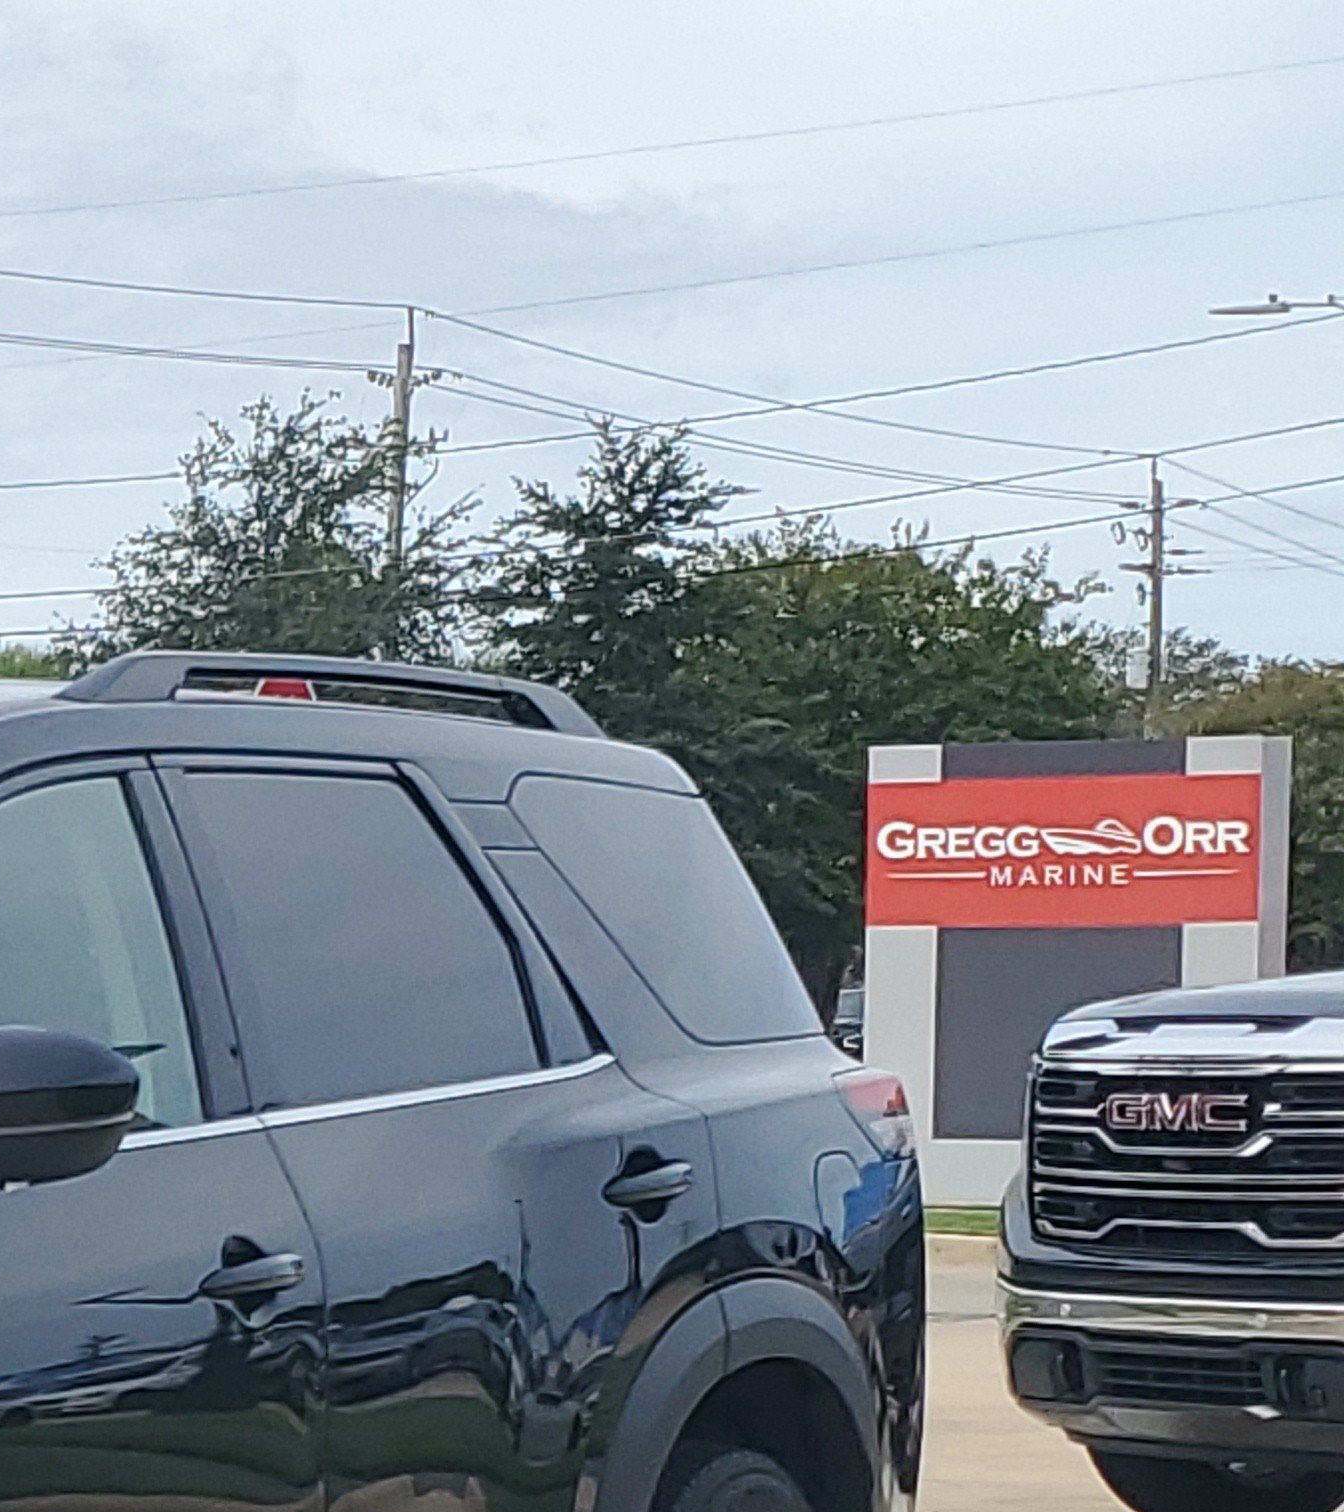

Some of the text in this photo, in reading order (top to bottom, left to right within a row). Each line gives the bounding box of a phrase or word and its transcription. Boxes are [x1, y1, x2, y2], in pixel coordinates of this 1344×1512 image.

[876, 815, 1250, 859] GREGG ORR
[989, 864, 1130, 887] MARINE
[1105, 1093, 1249, 1133] GMC
